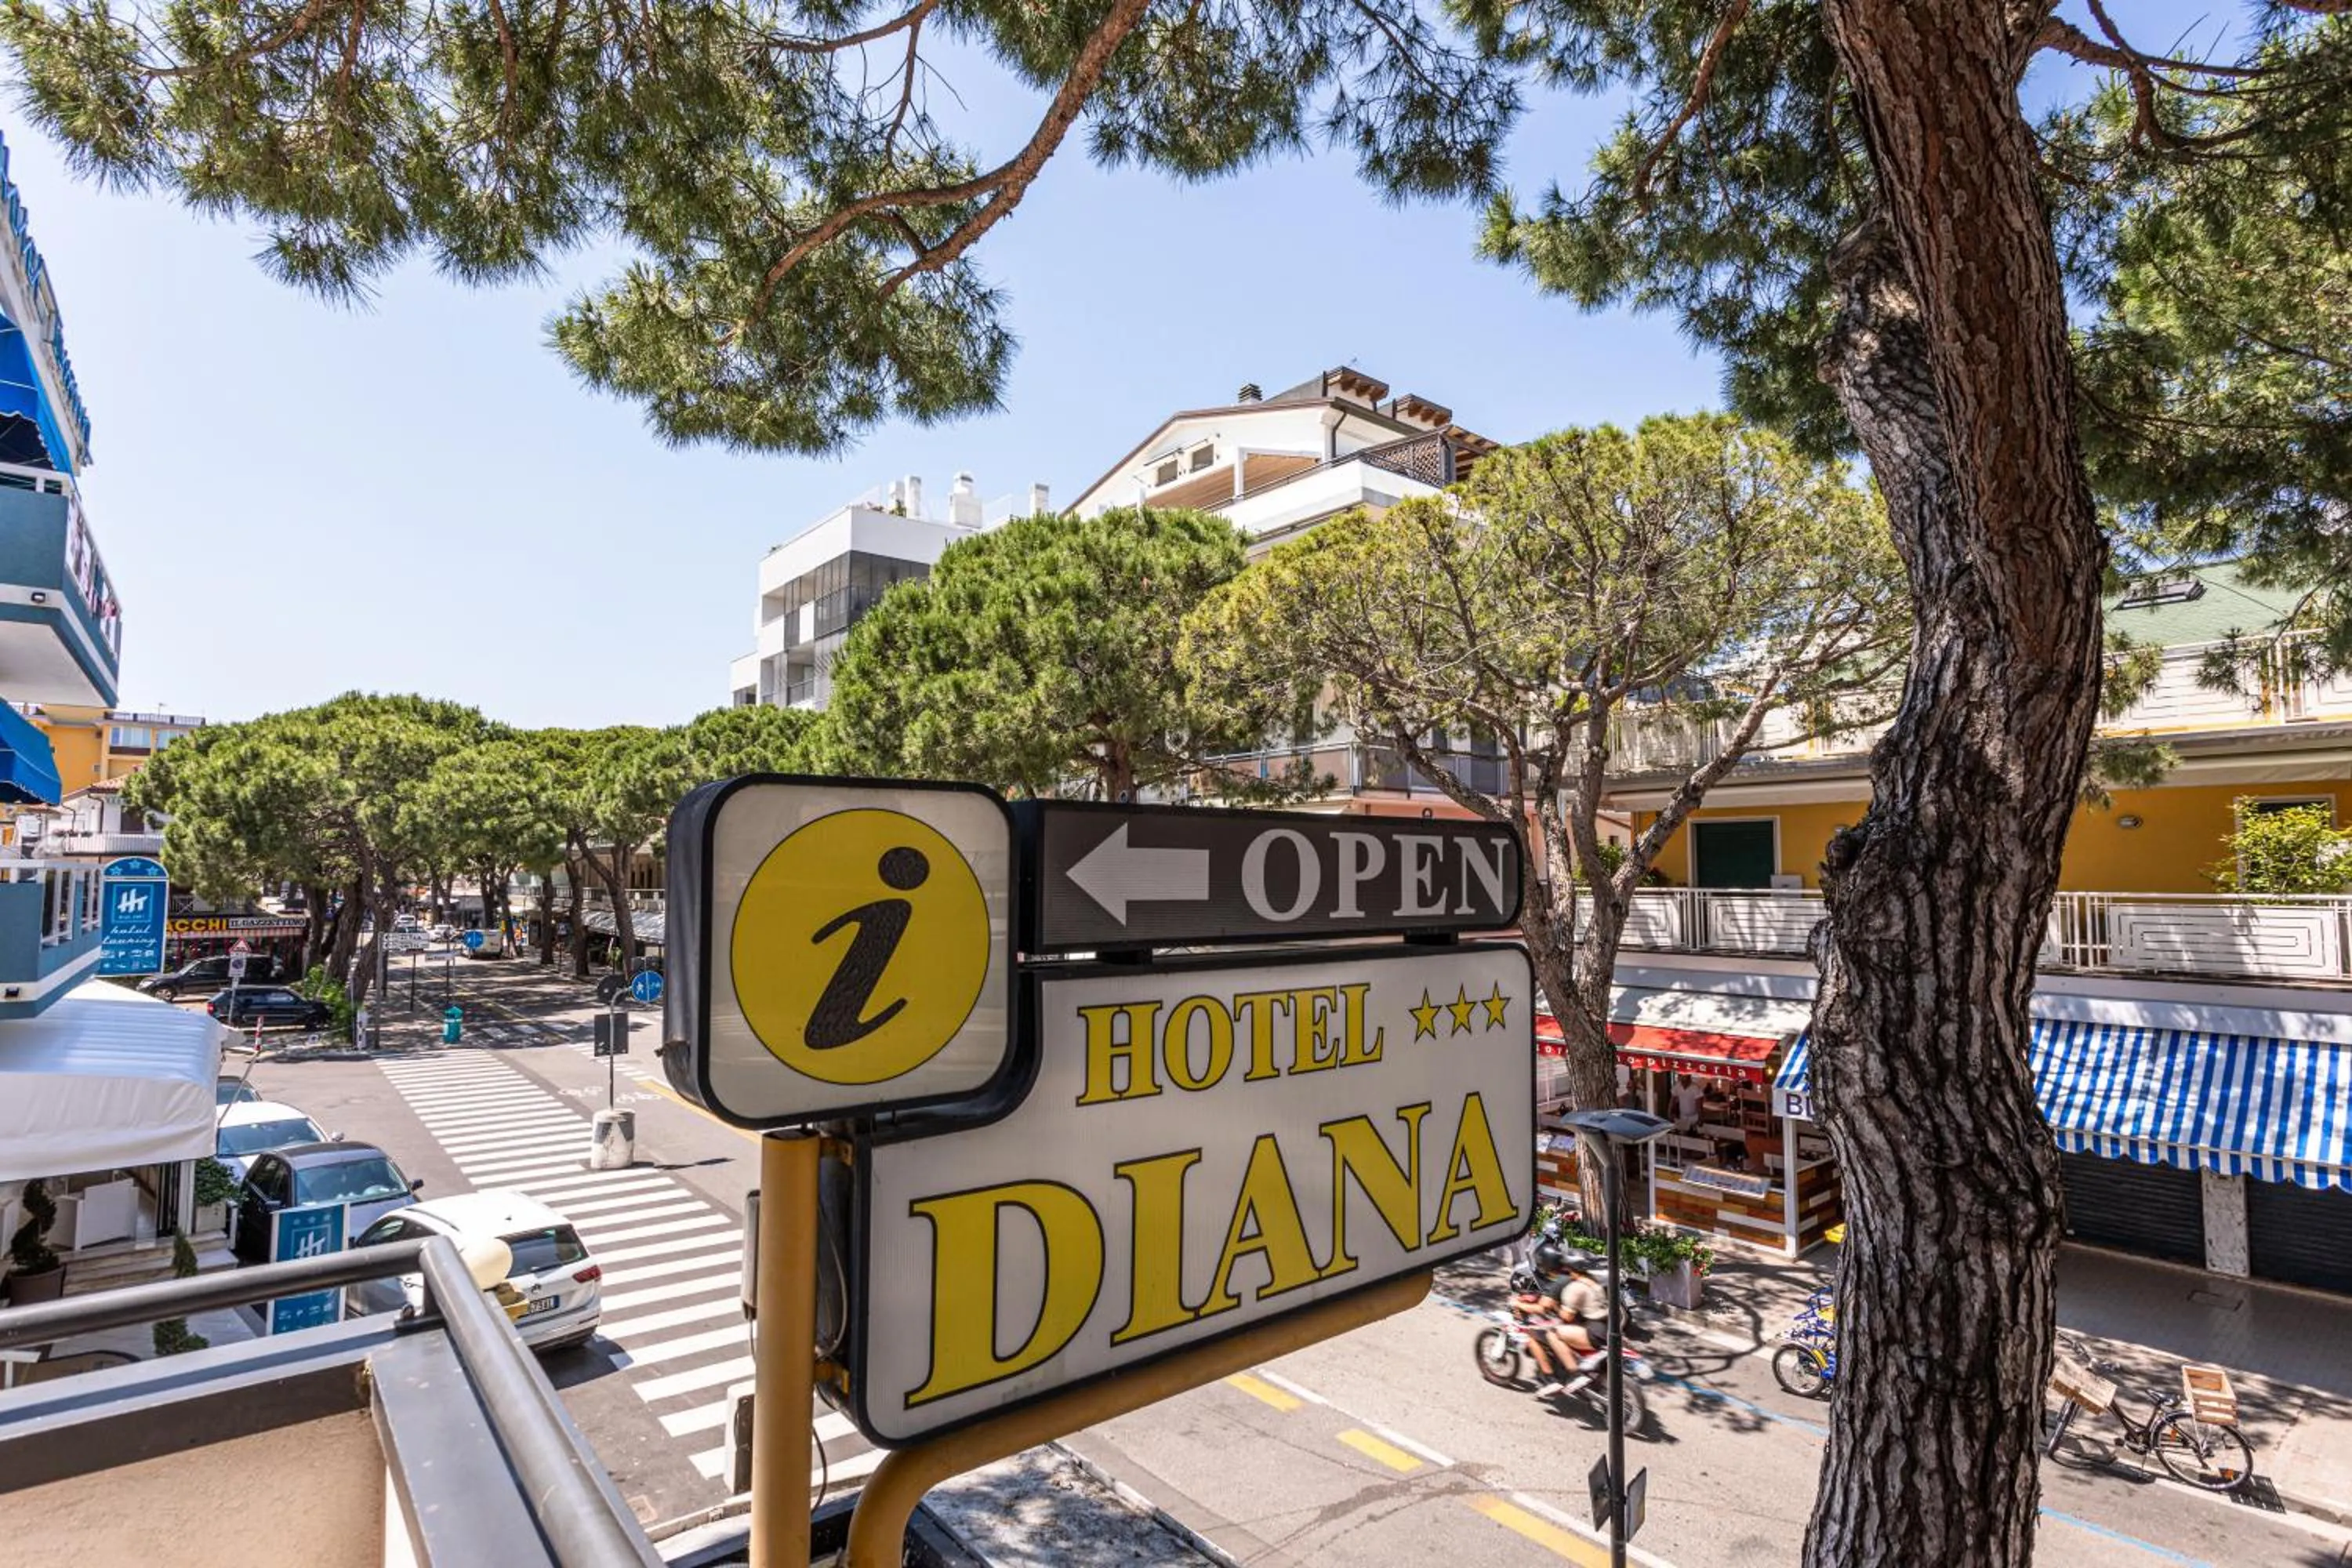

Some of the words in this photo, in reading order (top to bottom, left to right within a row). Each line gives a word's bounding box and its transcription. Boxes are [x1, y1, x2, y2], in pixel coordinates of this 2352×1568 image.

[1241, 829, 1510, 922] OPEN
[1076, 982, 1383, 1106] HOTEL
[904, 1091, 1518, 1410] DIANA
